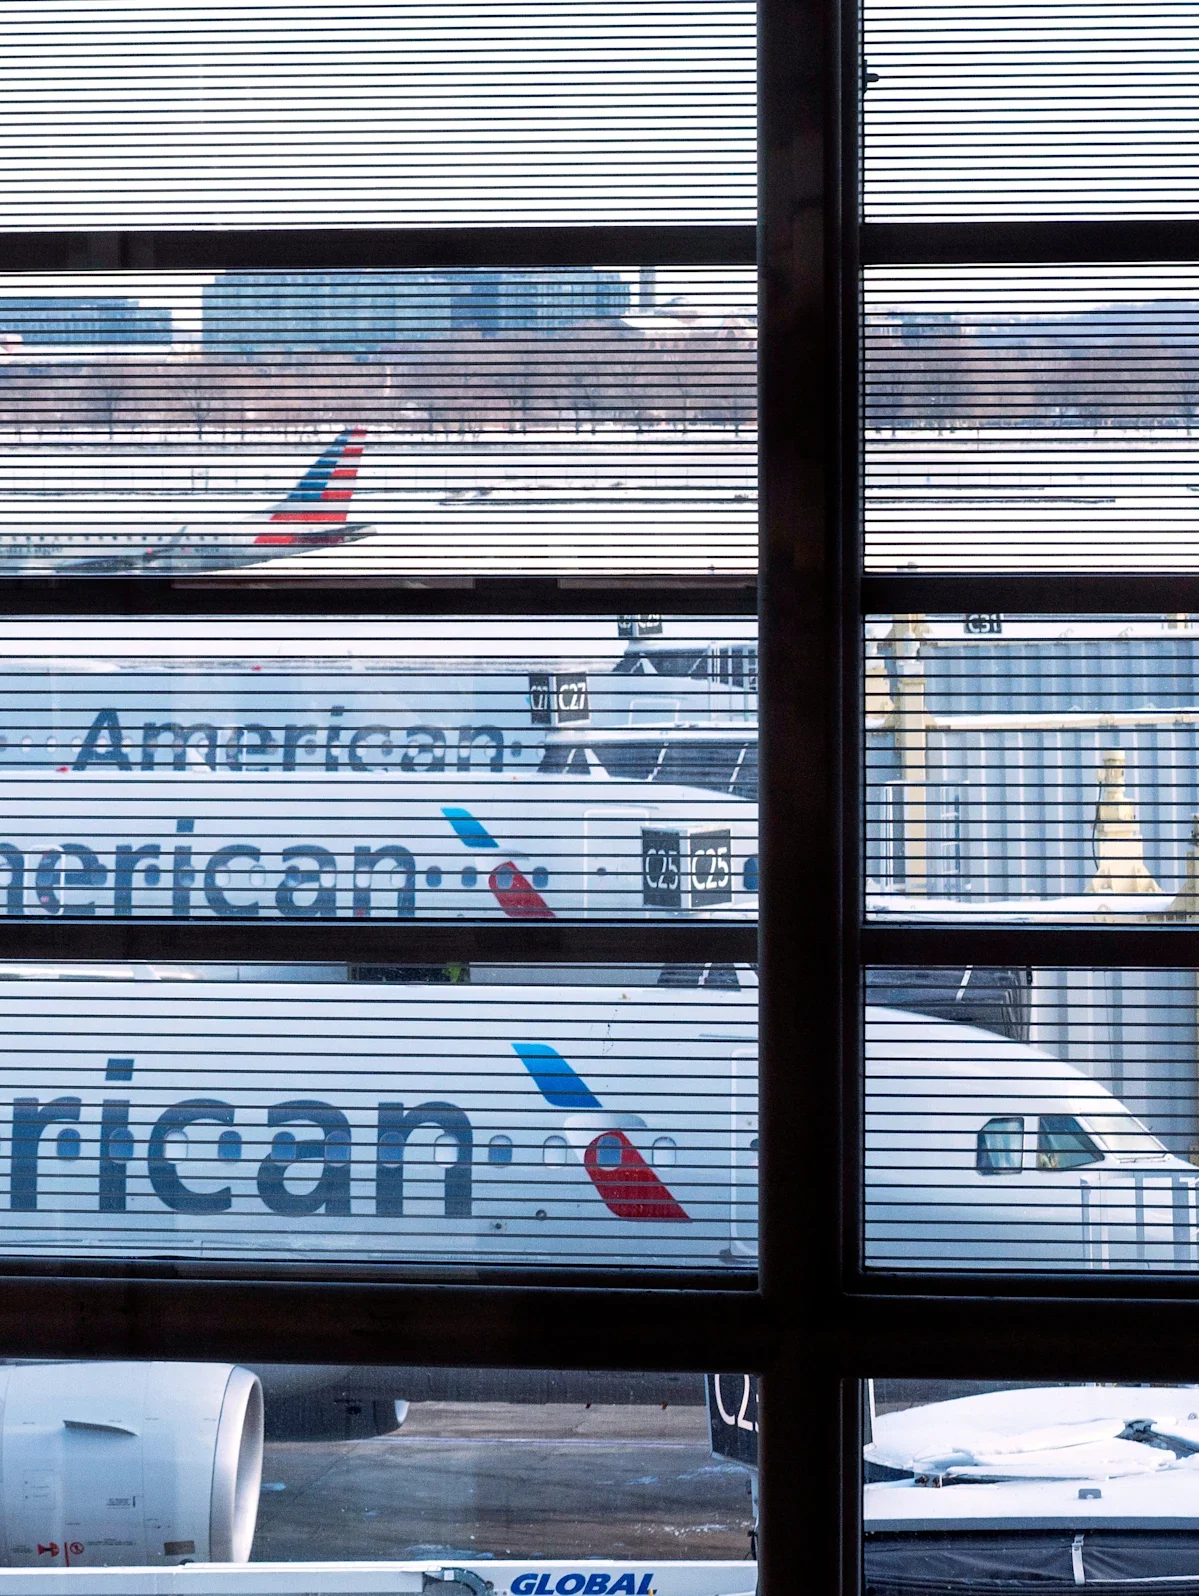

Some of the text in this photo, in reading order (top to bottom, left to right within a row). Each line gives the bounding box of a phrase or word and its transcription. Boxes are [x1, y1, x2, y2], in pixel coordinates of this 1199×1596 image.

[968, 613, 999, 633] C31
[558, 682, 586, 710] C27
[72, 706, 505, 772] American
[646, 848, 678, 889] C25
[692, 847, 729, 890] C25
[714, 1374, 760, 1433] C2
[510, 1573, 659, 1596] GLOBAL
